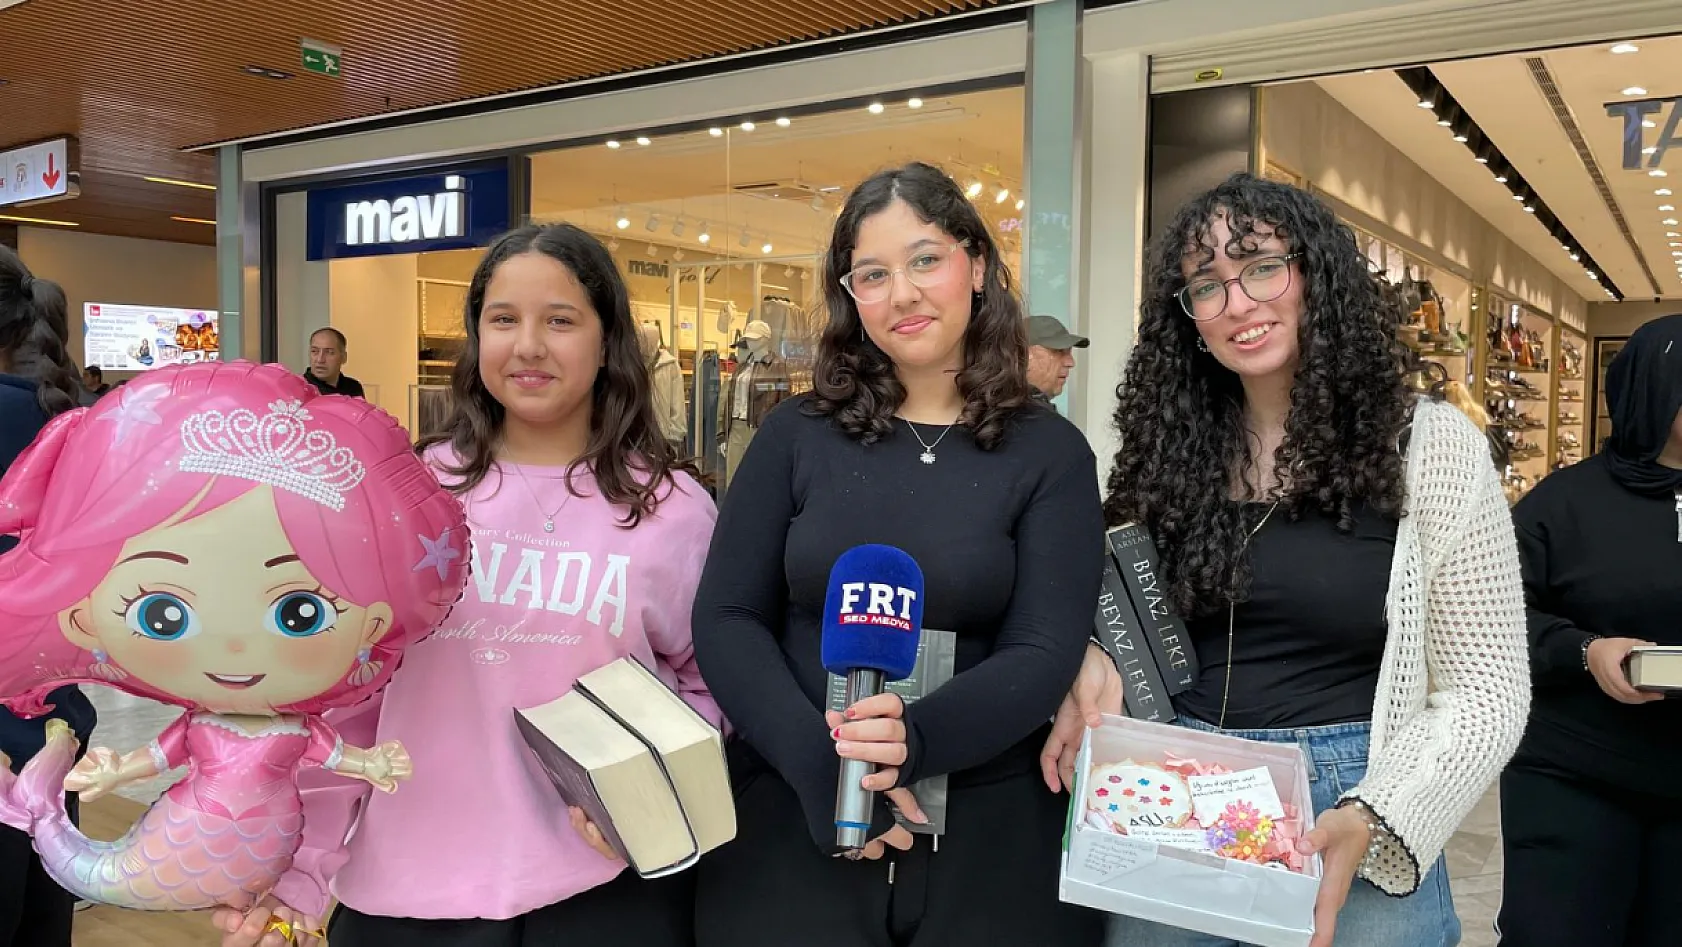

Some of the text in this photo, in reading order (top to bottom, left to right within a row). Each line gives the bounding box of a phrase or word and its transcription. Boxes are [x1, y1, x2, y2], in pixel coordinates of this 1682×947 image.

[346, 175, 465, 245] mavi
[629, 260, 669, 278] mavi
[506, 530, 570, 548] Collection
[463, 541, 630, 638] NADA
[840, 582, 917, 620] FRT
[432, 618, 583, 645] orth America
[871, 615, 910, 630] MEDYA
[1133, 559, 1189, 672] BEYAZ LEKE
[1098, 592, 1154, 706] BEYAZ LEKE
